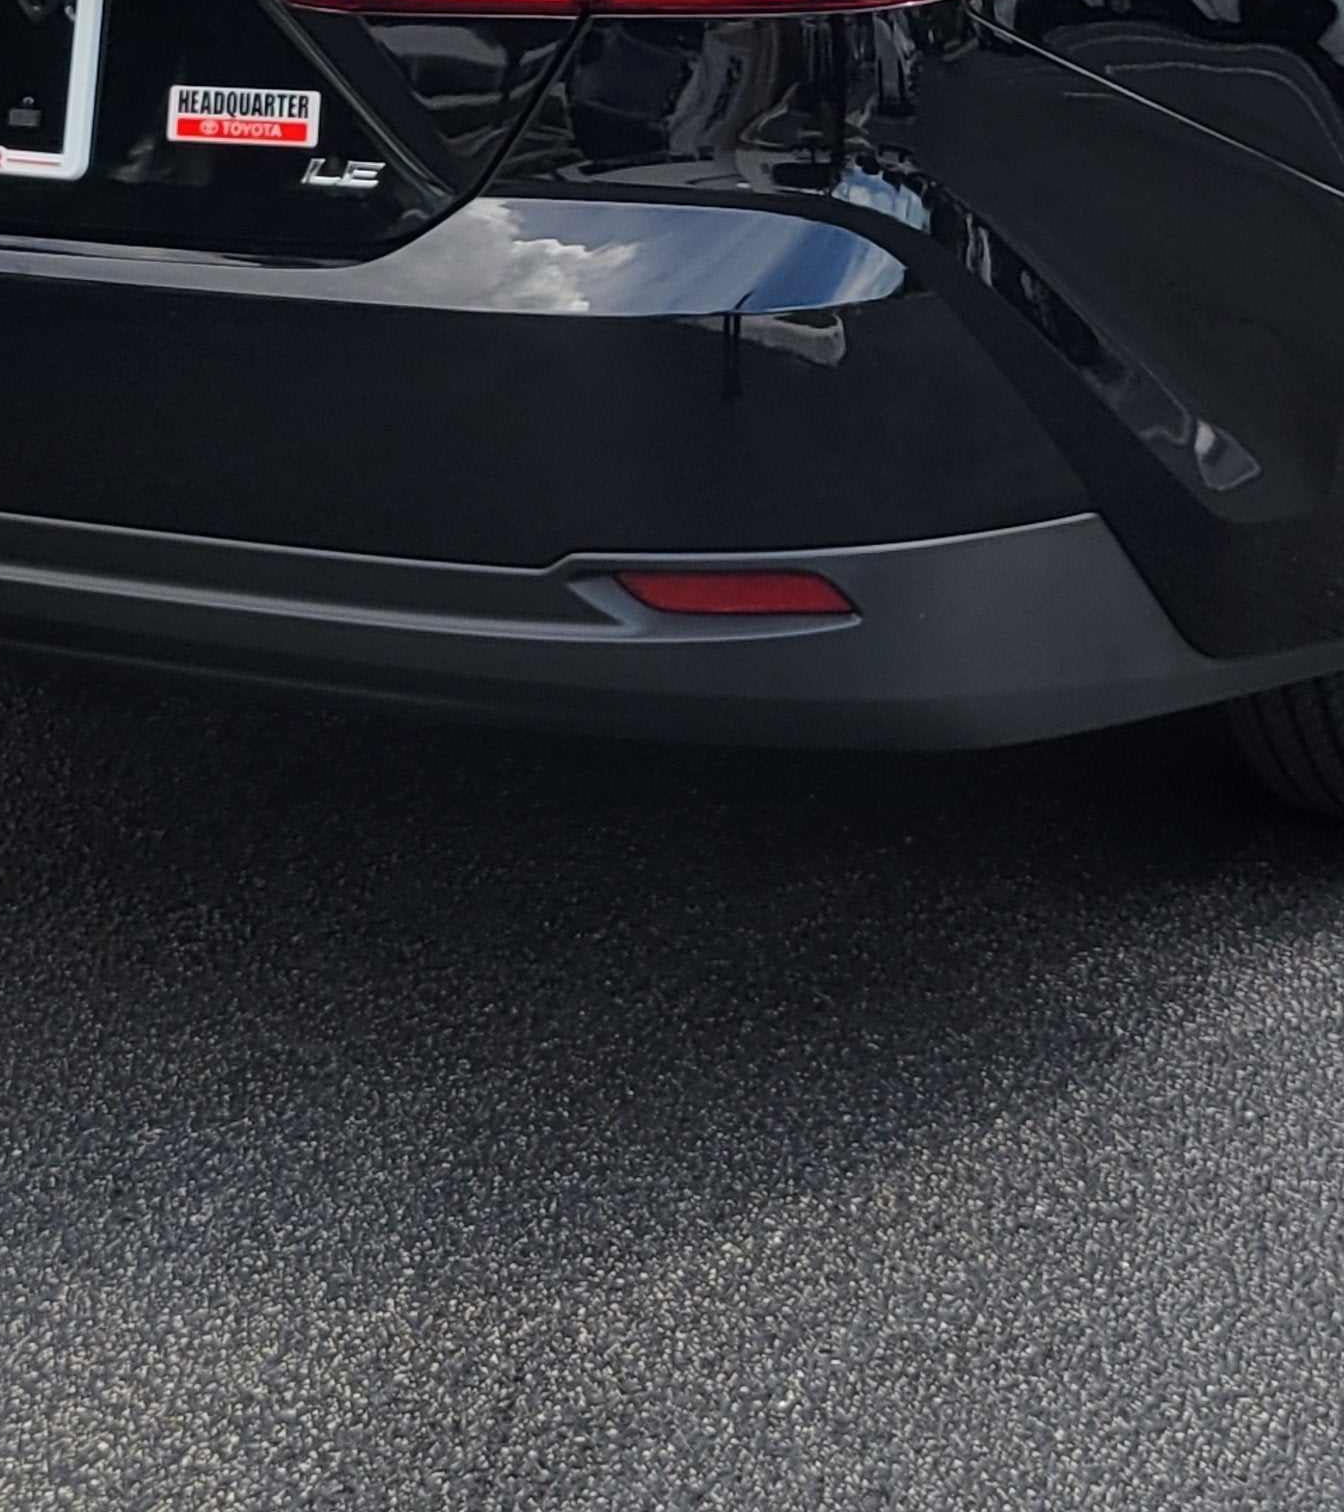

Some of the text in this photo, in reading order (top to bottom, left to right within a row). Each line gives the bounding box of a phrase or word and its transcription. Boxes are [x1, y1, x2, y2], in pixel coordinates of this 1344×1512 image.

[177, 90, 309, 119] HEADQUARTER
[222, 122, 282, 138] TOYOTA
[300, 158, 386, 188] LE
